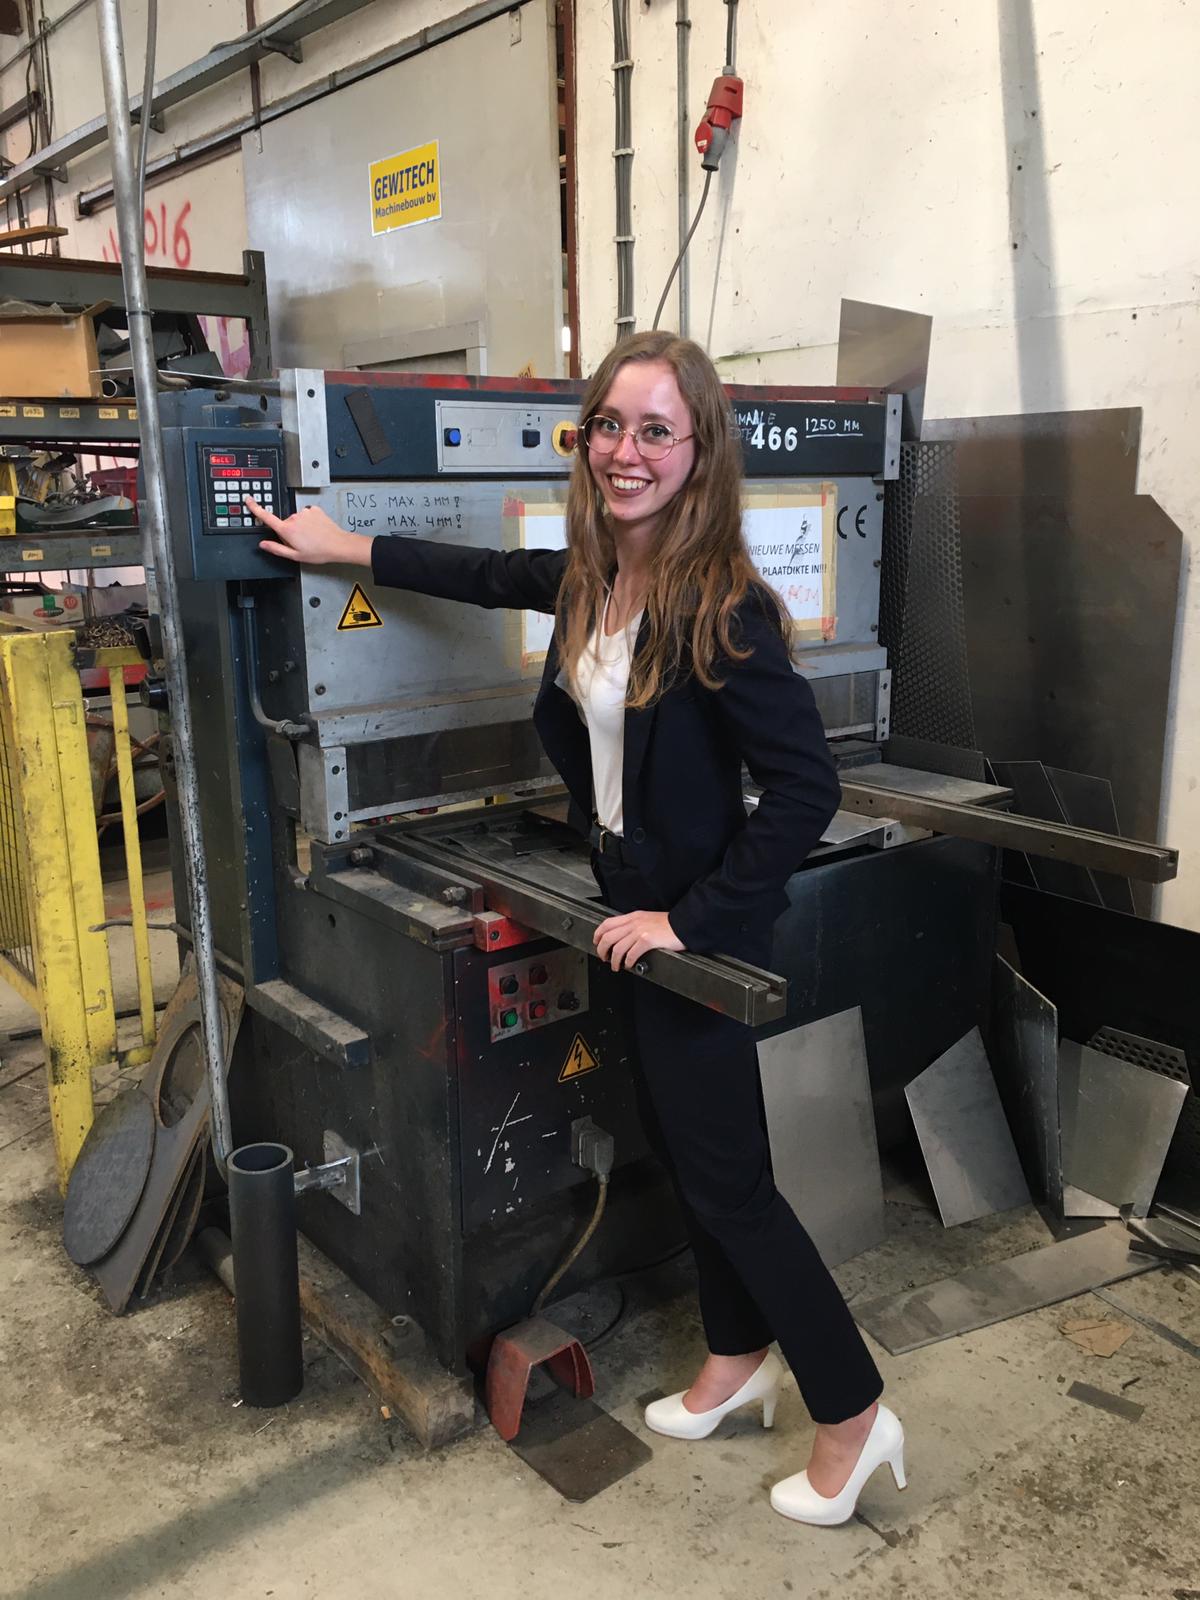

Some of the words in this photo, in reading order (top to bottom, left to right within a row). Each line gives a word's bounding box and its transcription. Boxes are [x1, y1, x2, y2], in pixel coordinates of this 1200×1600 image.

[374, 159, 435, 201] GEWITECH
[375, 195, 426, 219] Machinebouw
[427, 191, 437, 203] bv
[805, 417, 837, 433] 1250
[843, 419, 861, 432] MM
[751, 423, 798, 452] 466
[346, 492, 377, 509] RVS
[837, 505, 868, 540] CE
[785, 543, 820, 555] MESSEN
[762, 565, 809, 576] PLAATDIKTE
